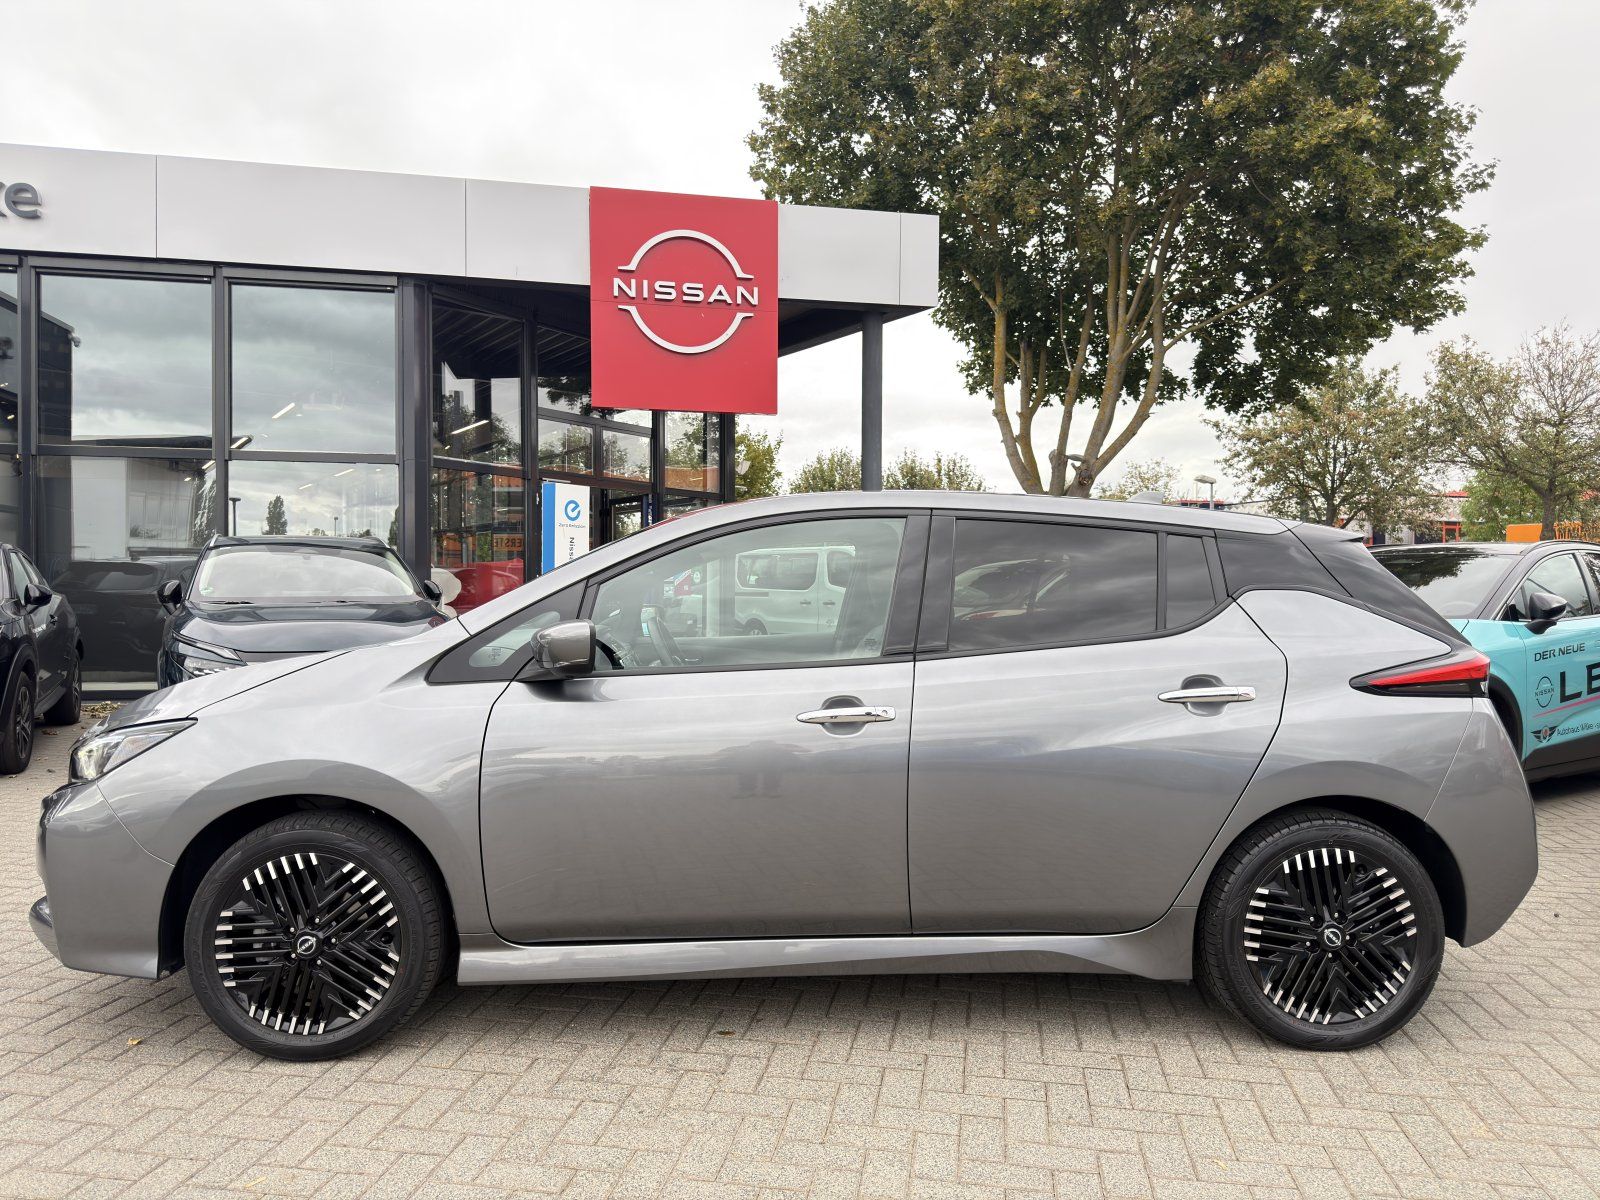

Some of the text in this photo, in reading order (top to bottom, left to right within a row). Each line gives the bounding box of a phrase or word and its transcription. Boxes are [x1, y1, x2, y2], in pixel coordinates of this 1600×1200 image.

[613, 277, 758, 305] NISSAN
[1534, 643, 1586, 662] DER NEUE
[1534, 688, 1555, 697] NISSAN
